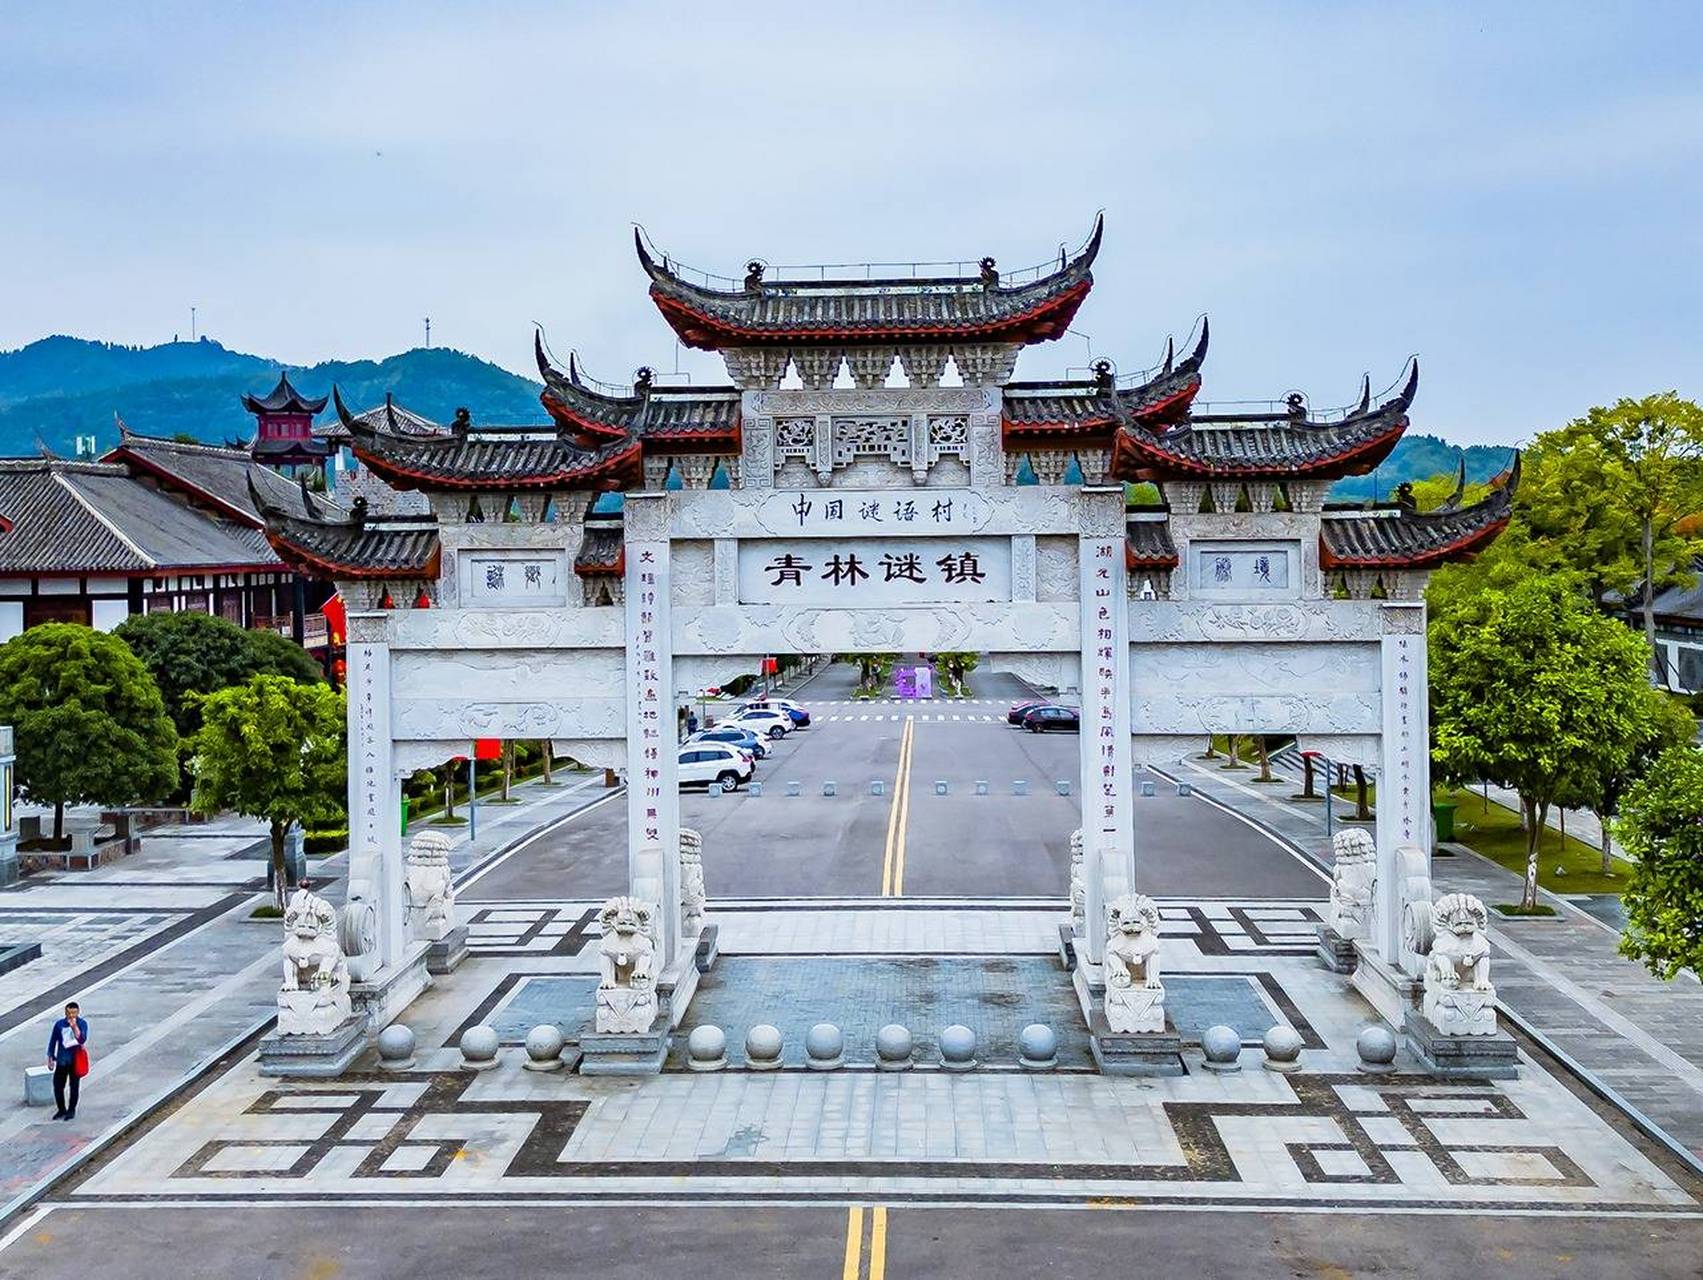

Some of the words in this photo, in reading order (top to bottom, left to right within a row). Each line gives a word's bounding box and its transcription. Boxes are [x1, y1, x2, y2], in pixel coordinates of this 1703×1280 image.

[792, 494, 953, 526] 中国谜语村
[764, 552, 986, 586] 青林谜镇
